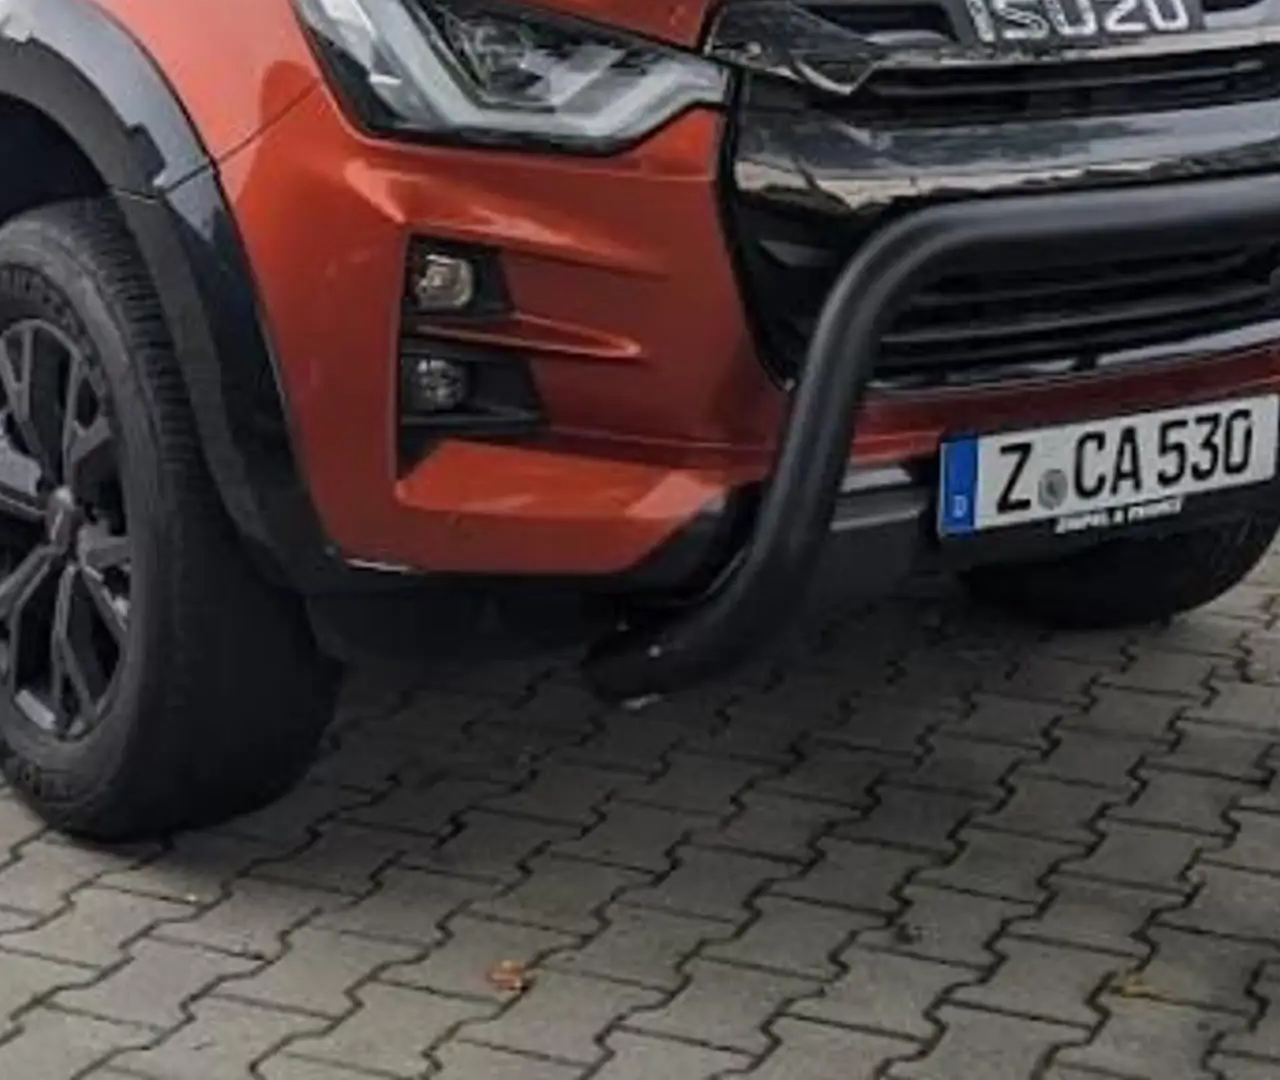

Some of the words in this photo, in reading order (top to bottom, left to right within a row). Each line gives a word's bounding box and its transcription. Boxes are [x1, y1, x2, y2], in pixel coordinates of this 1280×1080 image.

[996, 442, 1033, 514] Z
[1073, 428, 1143, 499] CA
[1155, 408, 1253, 488] 530
